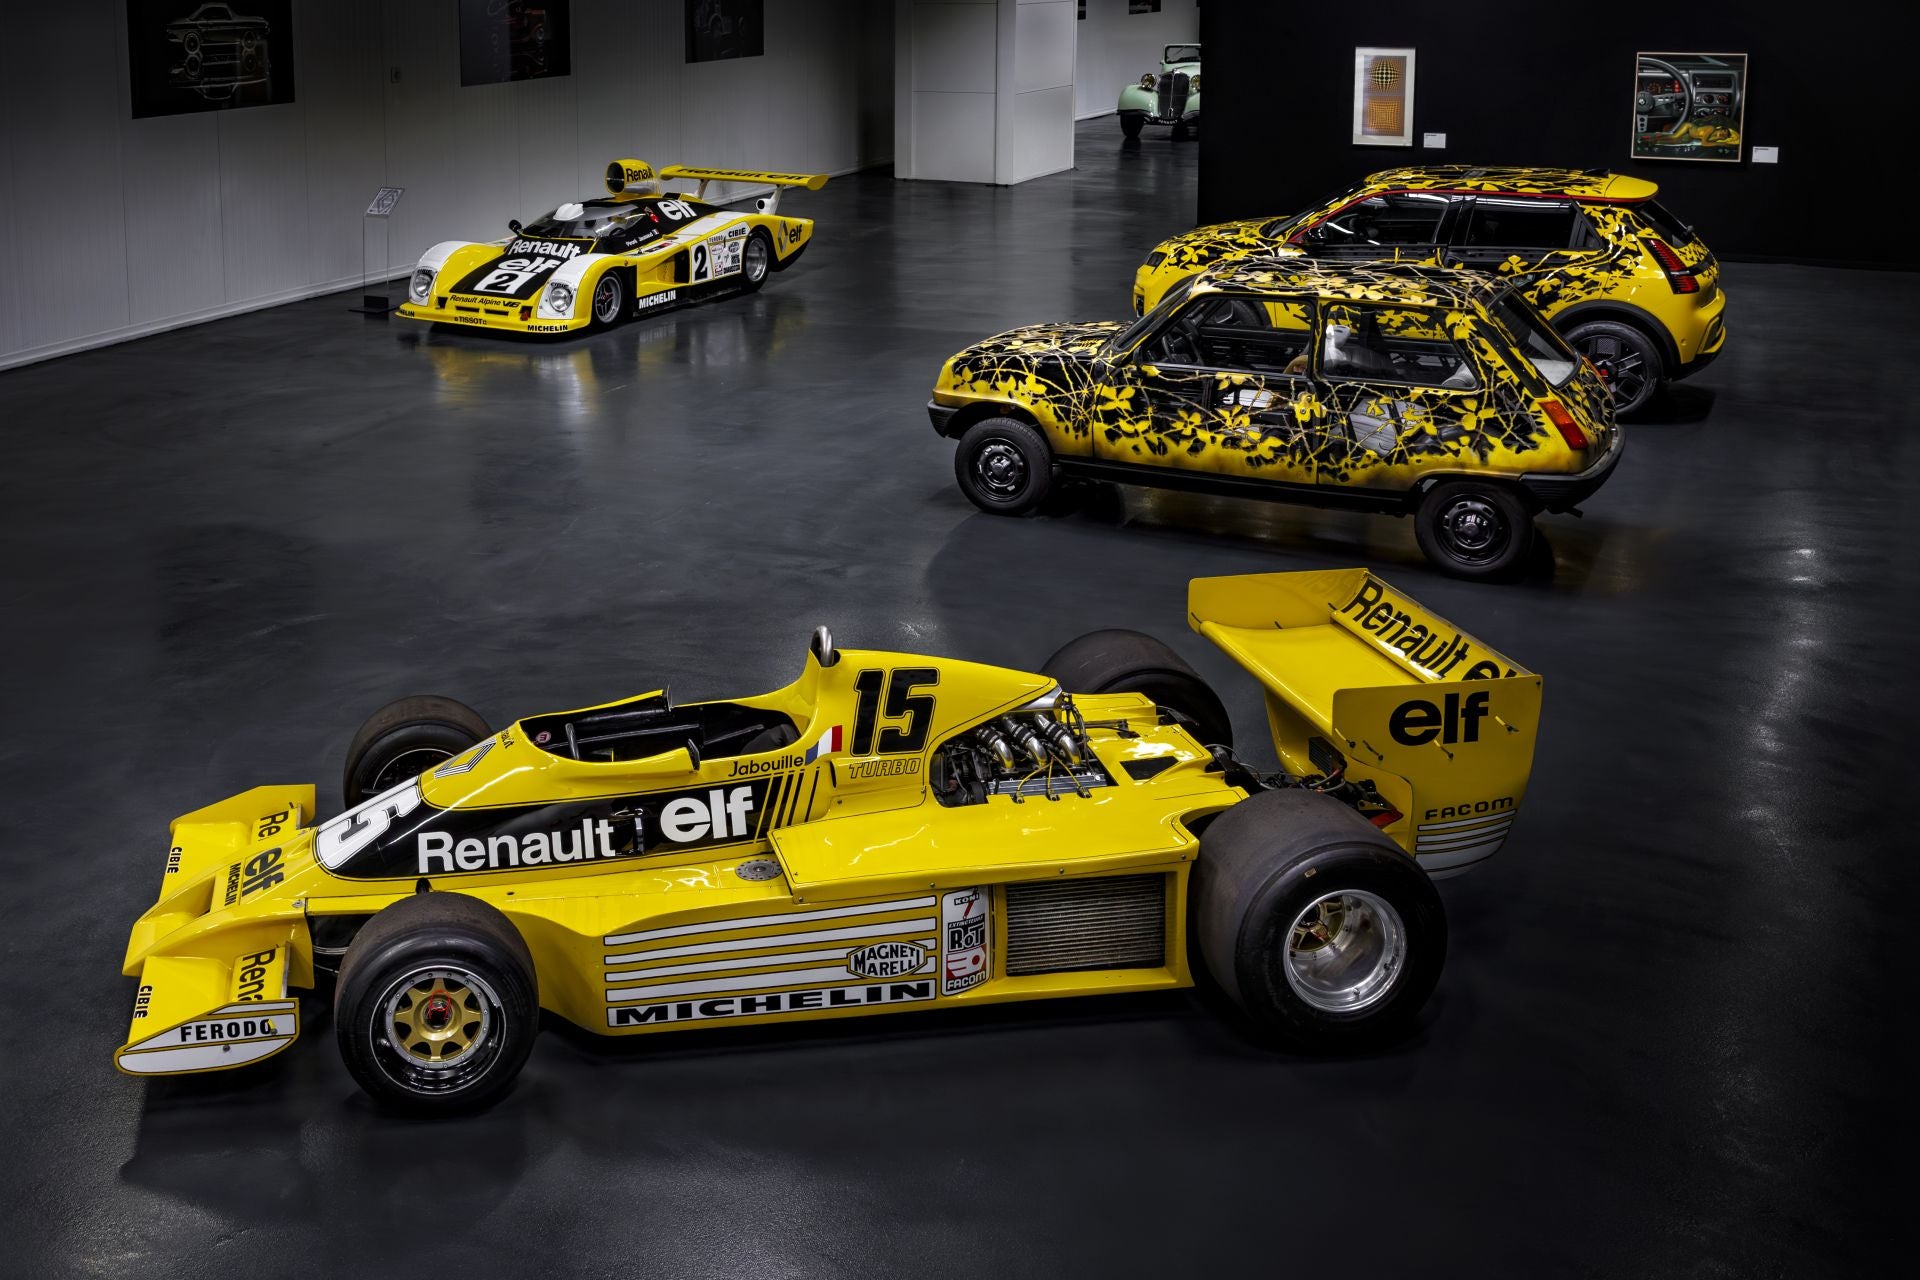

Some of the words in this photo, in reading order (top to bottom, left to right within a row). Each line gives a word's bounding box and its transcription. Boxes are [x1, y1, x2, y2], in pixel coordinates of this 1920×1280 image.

[658, 200, 697, 221] elf
[728, 228, 746, 238] CIBIE
[789, 223, 803, 244] elf
[508, 239, 581, 259] Renault
[498, 256, 564, 273] elf
[694, 244, 708, 281] 2
[484, 273, 519, 292] 2
[450, 295, 478, 304] Renault
[478, 298, 501, 306] Alpine
[639, 290, 677, 309] MICHELIN
[459, 316, 483, 325] TISSOT
[527, 324, 568, 332] MICHELIN
[1340, 578, 1472, 683] Renault
[850, 667, 940, 757] 15
[1389, 691, 1490, 747] elf
[728, 755, 804, 777] Jabouille
[849, 757, 922, 780] TURBO
[660, 786, 754, 843] elf
[1425, 797, 1514, 821] FACOM
[418, 818, 616, 874] Renault
[166, 846, 183, 874] CIBIE
[242, 847, 285, 897] elf
[224, 862, 242, 907] MICHELIN
[954, 893, 979, 906] KONI
[854, 944, 920, 973] MAGNETI
[947, 971, 986, 990] FACOM
[133, 985, 153, 1019] CIBIE
[616, 983, 931, 1025] MICHELIN
[181, 1019, 273, 1042] FERODO
